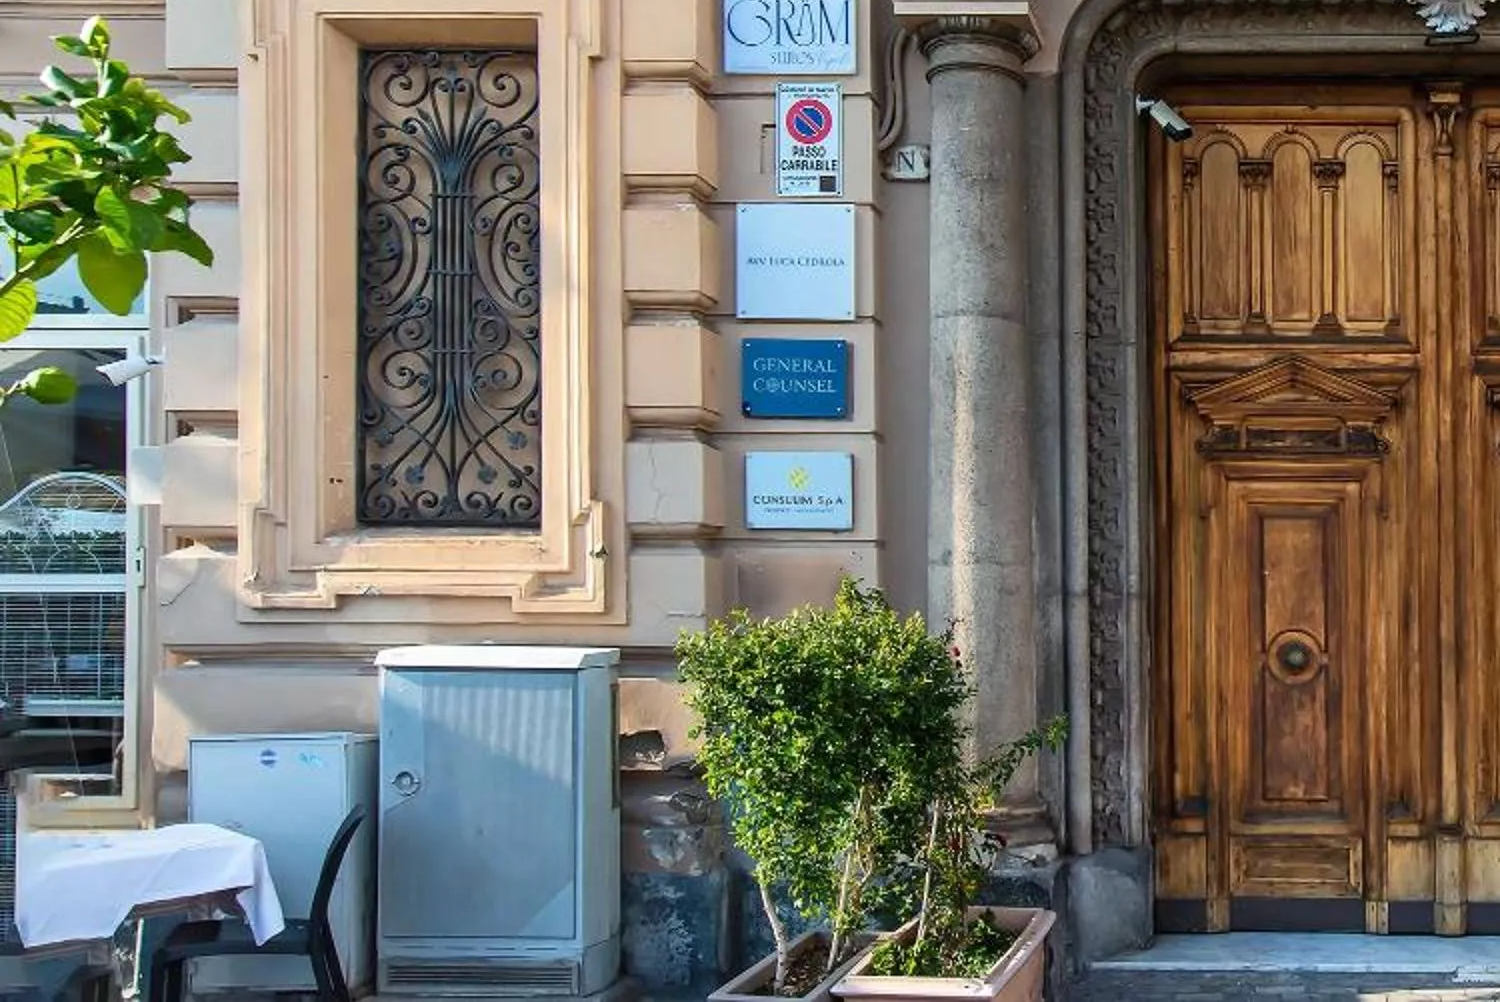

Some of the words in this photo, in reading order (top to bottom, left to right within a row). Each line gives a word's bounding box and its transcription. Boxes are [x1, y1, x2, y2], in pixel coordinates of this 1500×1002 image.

[791, 145, 827, 158] PASSO
[781, 159, 838, 171] CARRABILE
[753, 357, 837, 373] GENERAL
[753, 377, 837, 393] COUNSEL
